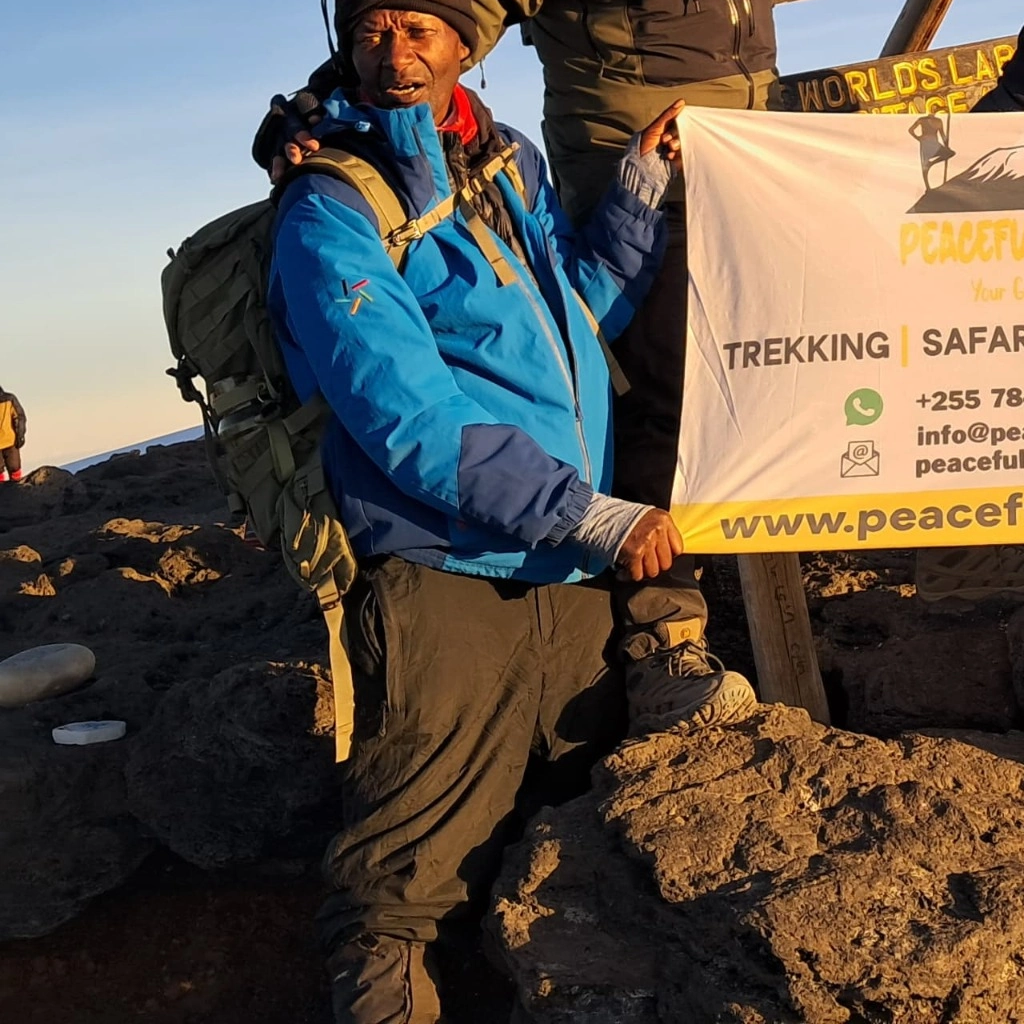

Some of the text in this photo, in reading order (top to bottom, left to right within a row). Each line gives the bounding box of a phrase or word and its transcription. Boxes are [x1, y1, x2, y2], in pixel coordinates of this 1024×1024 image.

[971, 277, 1006, 303] Your
[723, 331, 890, 370] TREKKING
[916, 389, 981, 411] +255
